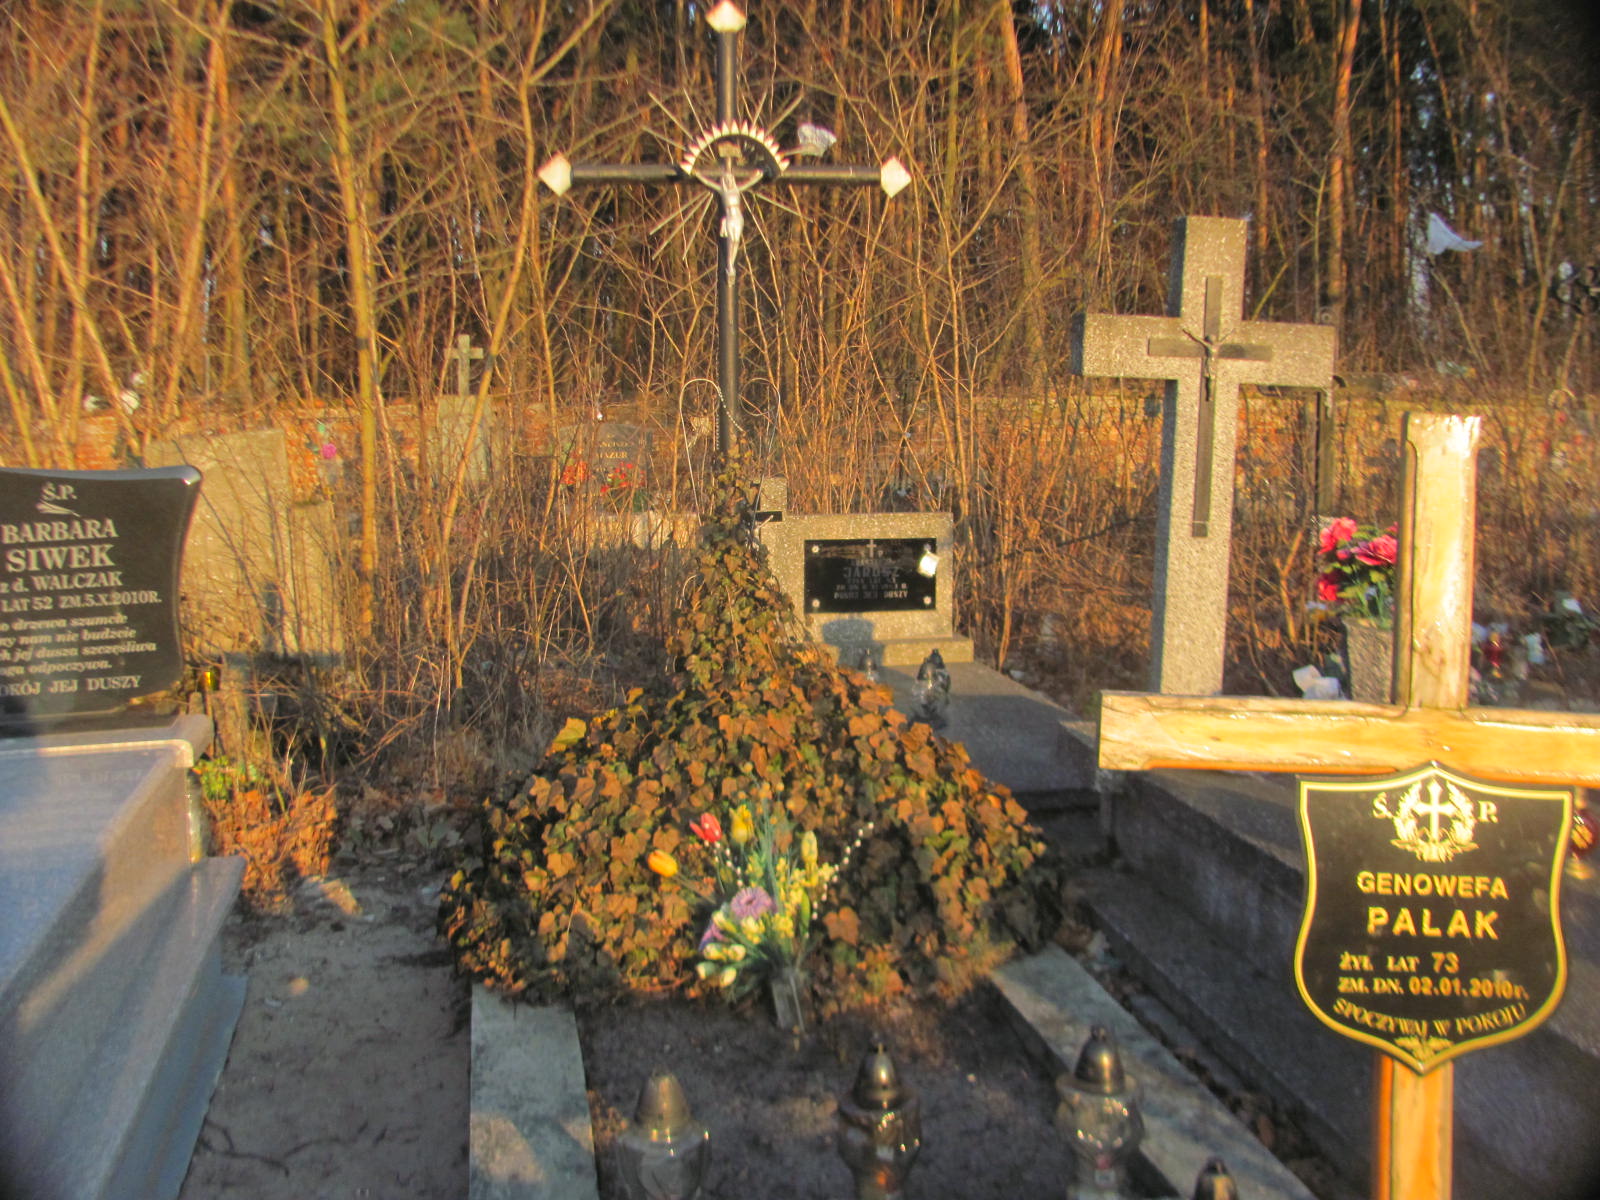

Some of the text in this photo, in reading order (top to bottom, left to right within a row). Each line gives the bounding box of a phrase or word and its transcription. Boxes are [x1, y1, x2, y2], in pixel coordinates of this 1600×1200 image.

[1, 518, 120, 544] BARBARA
[5, 544, 116, 572] SIWEK
[31, 571, 123, 591] WALCZAK
[1, 598, 30, 612] LAT
[32, 596, 53, 610] 52
[55, 630, 79, 642] nie
[35, 646, 79, 659] dusza
[0, 675, 142, 697] OKÓJ JEJ DUSZY
[1356, 870, 1510, 900] GENOWEFA
[1366, 906, 1499, 940] PALAK
[1387, 955, 1420, 973] LAT
[1431, 951, 1460, 974] 73
[1337, 976, 1371, 993] ZM.
[1373, 977, 1405, 994] DN.
[1333, 998, 1527, 1038] SPOCZYWAJ W POKOJU
